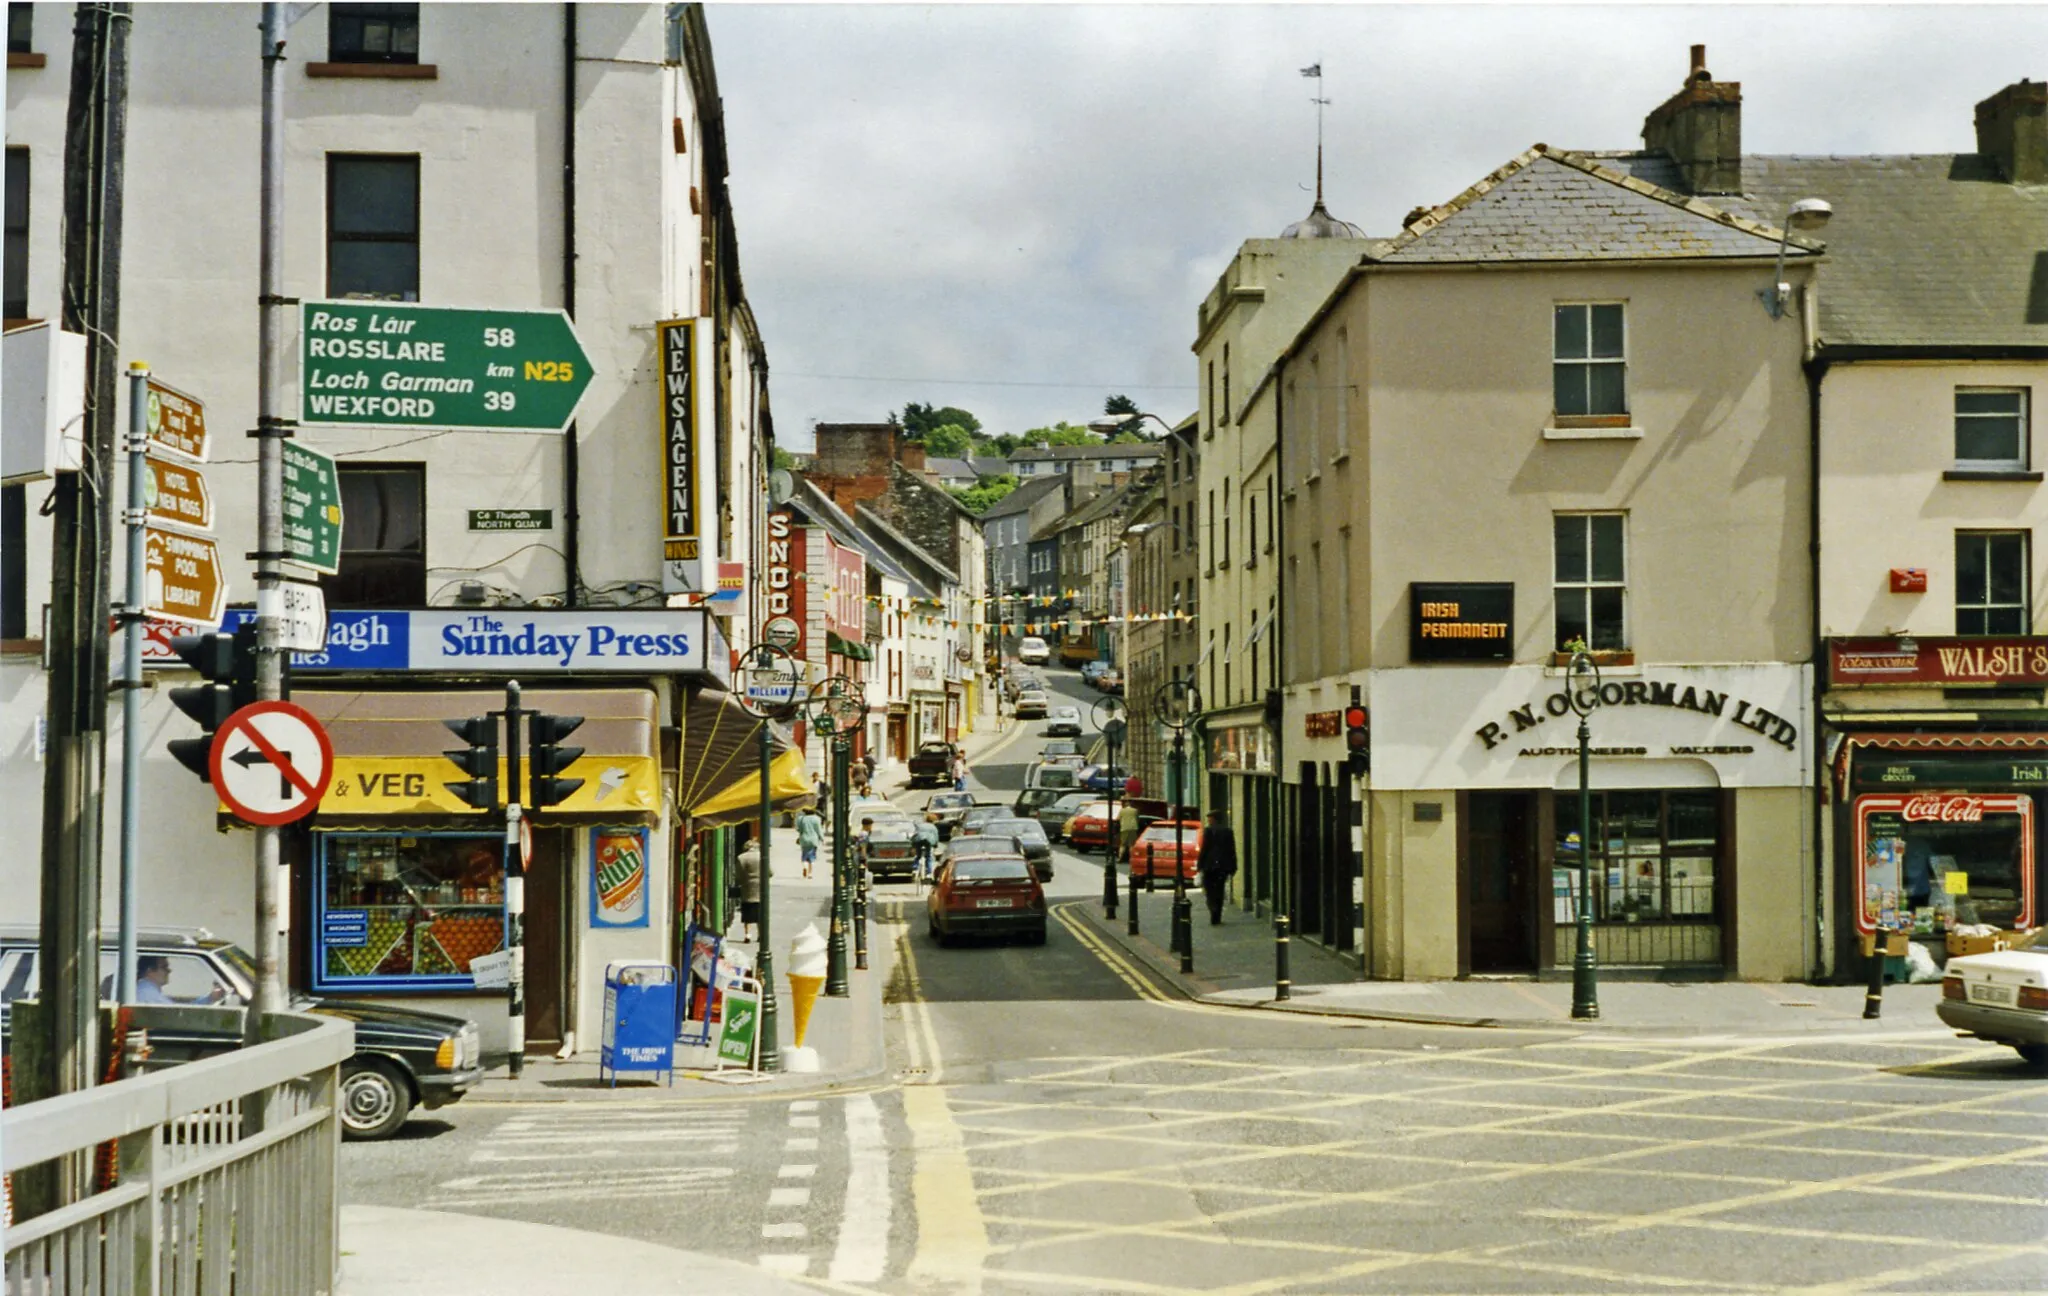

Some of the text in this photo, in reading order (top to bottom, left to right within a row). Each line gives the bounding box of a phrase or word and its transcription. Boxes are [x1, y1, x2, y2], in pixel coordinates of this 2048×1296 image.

[310, 311, 358, 332] Ros
[483, 327, 516, 348] 58
[309, 337, 446, 362] ROSSLARE
[309, 368, 475, 394] Loch Garman
[486, 362, 515, 379] km
[523, 361, 575, 383] N25
[309, 394, 436, 419] WEXFORD
[483, 391, 516, 412] 39
[666, 326, 690, 535] NEWSAGENT
[164, 471, 191, 493] HOTEL
[159, 491, 201, 518] NEW ROSS
[476, 520, 542, 529] NORTH QUAY
[165, 536, 210, 562] SWIMMING
[175, 557, 199, 578] POOL
[165, 584, 202, 607] LIBRARY
[1421, 602, 1459, 618] IRISH
[468, 615, 504, 633] The
[1421, 622, 1508, 639] PERMANENT
[442, 622, 690, 667] Sunday Press
[1937, 646, 2048, 677] WALSH'S
[1731, 700, 1799, 751] LTD.
[1670, 745, 1755, 755] VALUERS
[2011, 766, 2042, 780] Irish
[334, 772, 432, 799] & VEG.
[1902, 796, 1983, 822] Coca-Cola
[622, 1046, 641, 1056] THE
[631, 1053, 658, 1063] TIMES
